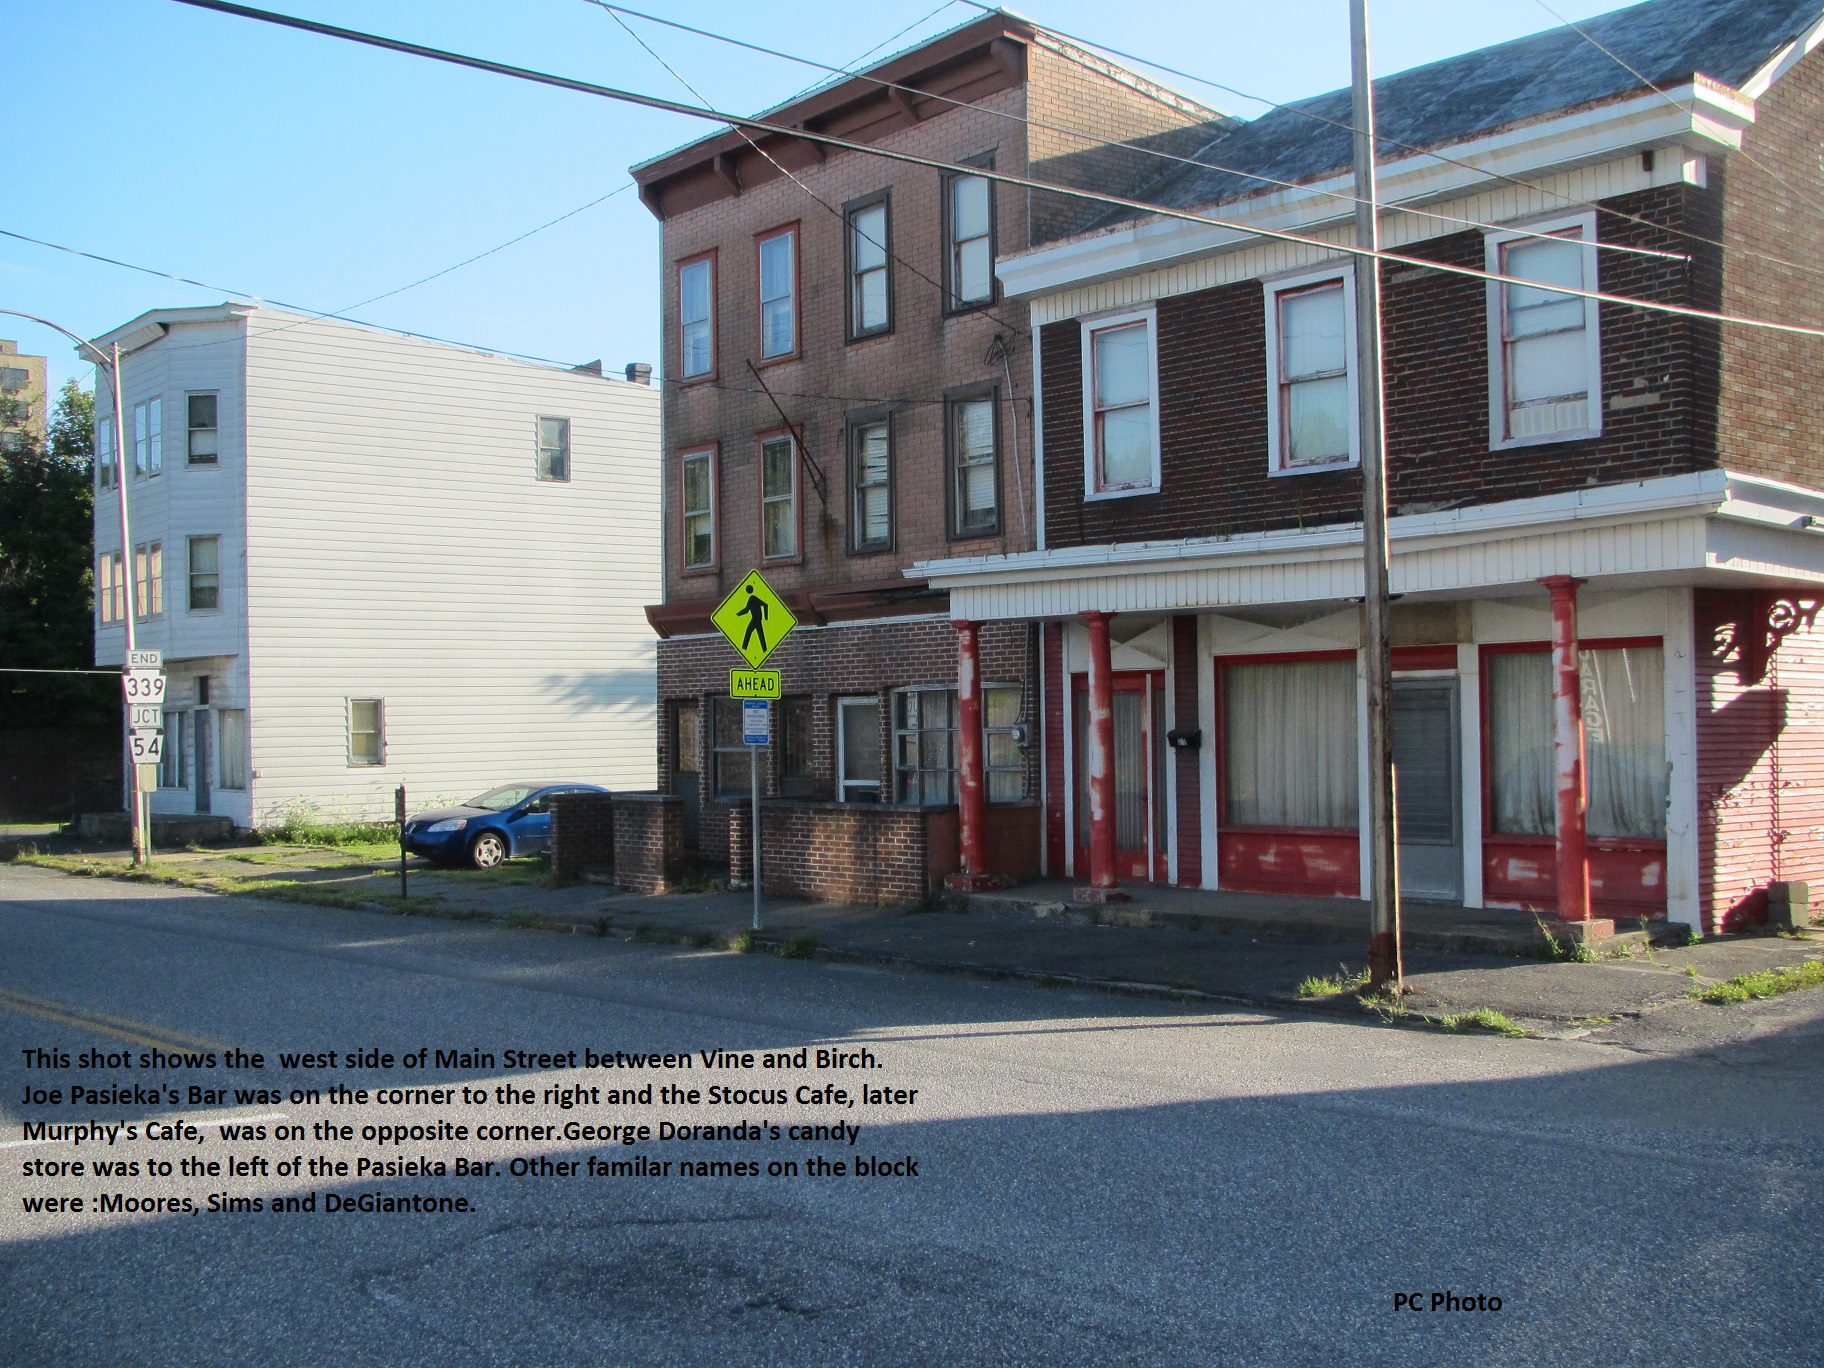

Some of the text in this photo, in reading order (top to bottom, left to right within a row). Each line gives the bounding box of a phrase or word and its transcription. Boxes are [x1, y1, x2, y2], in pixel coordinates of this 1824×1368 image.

[131, 653, 158, 664] END
[127, 677, 164, 697] 339
[737, 678, 774, 690] AHEAD
[133, 708, 159, 724] JCT
[134, 737, 160, 757] 54
